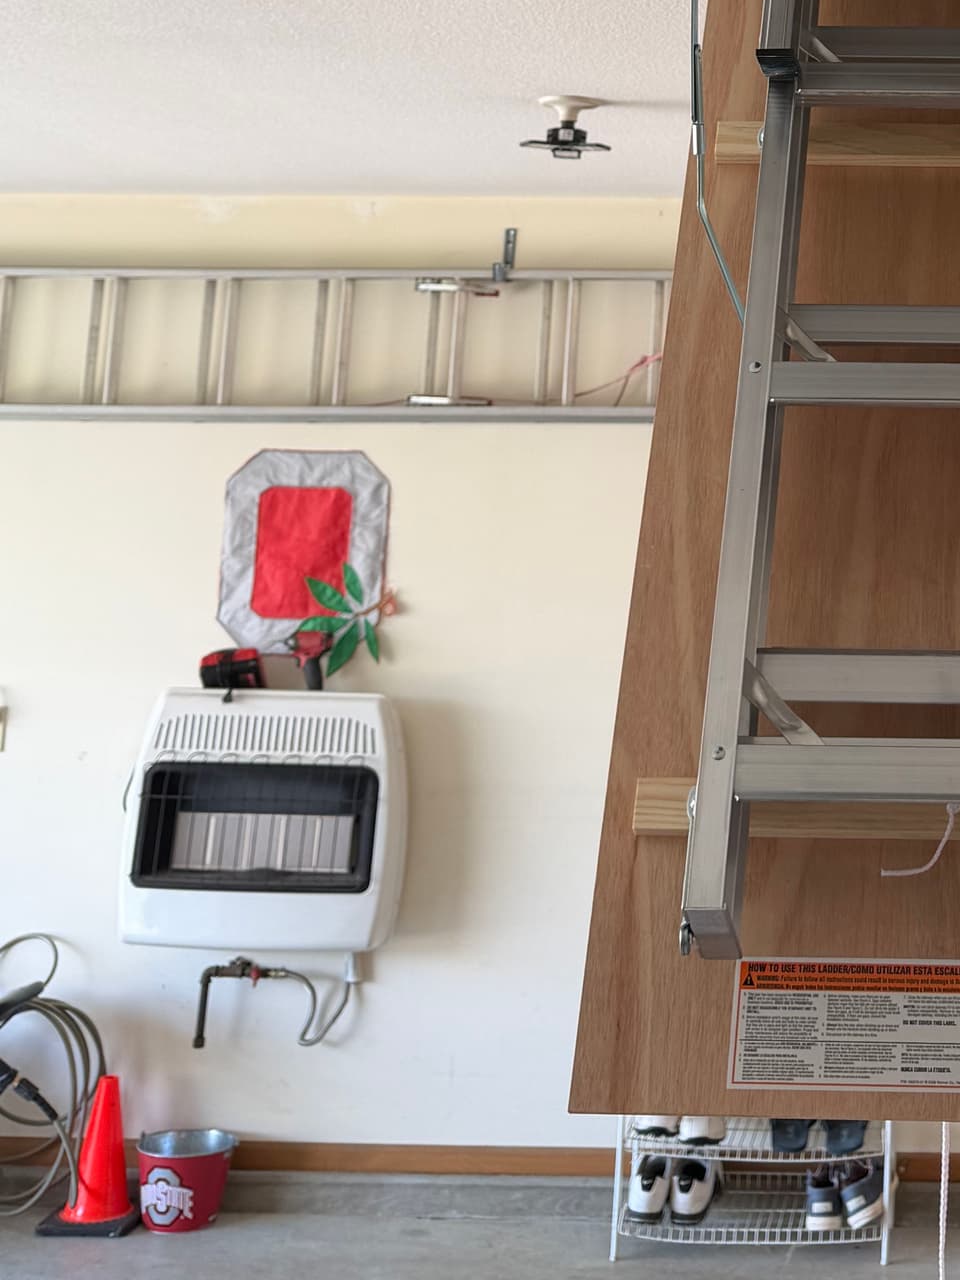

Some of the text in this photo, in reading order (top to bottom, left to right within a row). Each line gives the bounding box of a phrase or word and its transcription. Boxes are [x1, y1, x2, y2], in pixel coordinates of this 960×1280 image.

[748, 963, 766, 972] HOW
[769, 963, 779, 972] TO
[781, 964, 796, 972] USE
[799, 964, 816, 973] THIS
